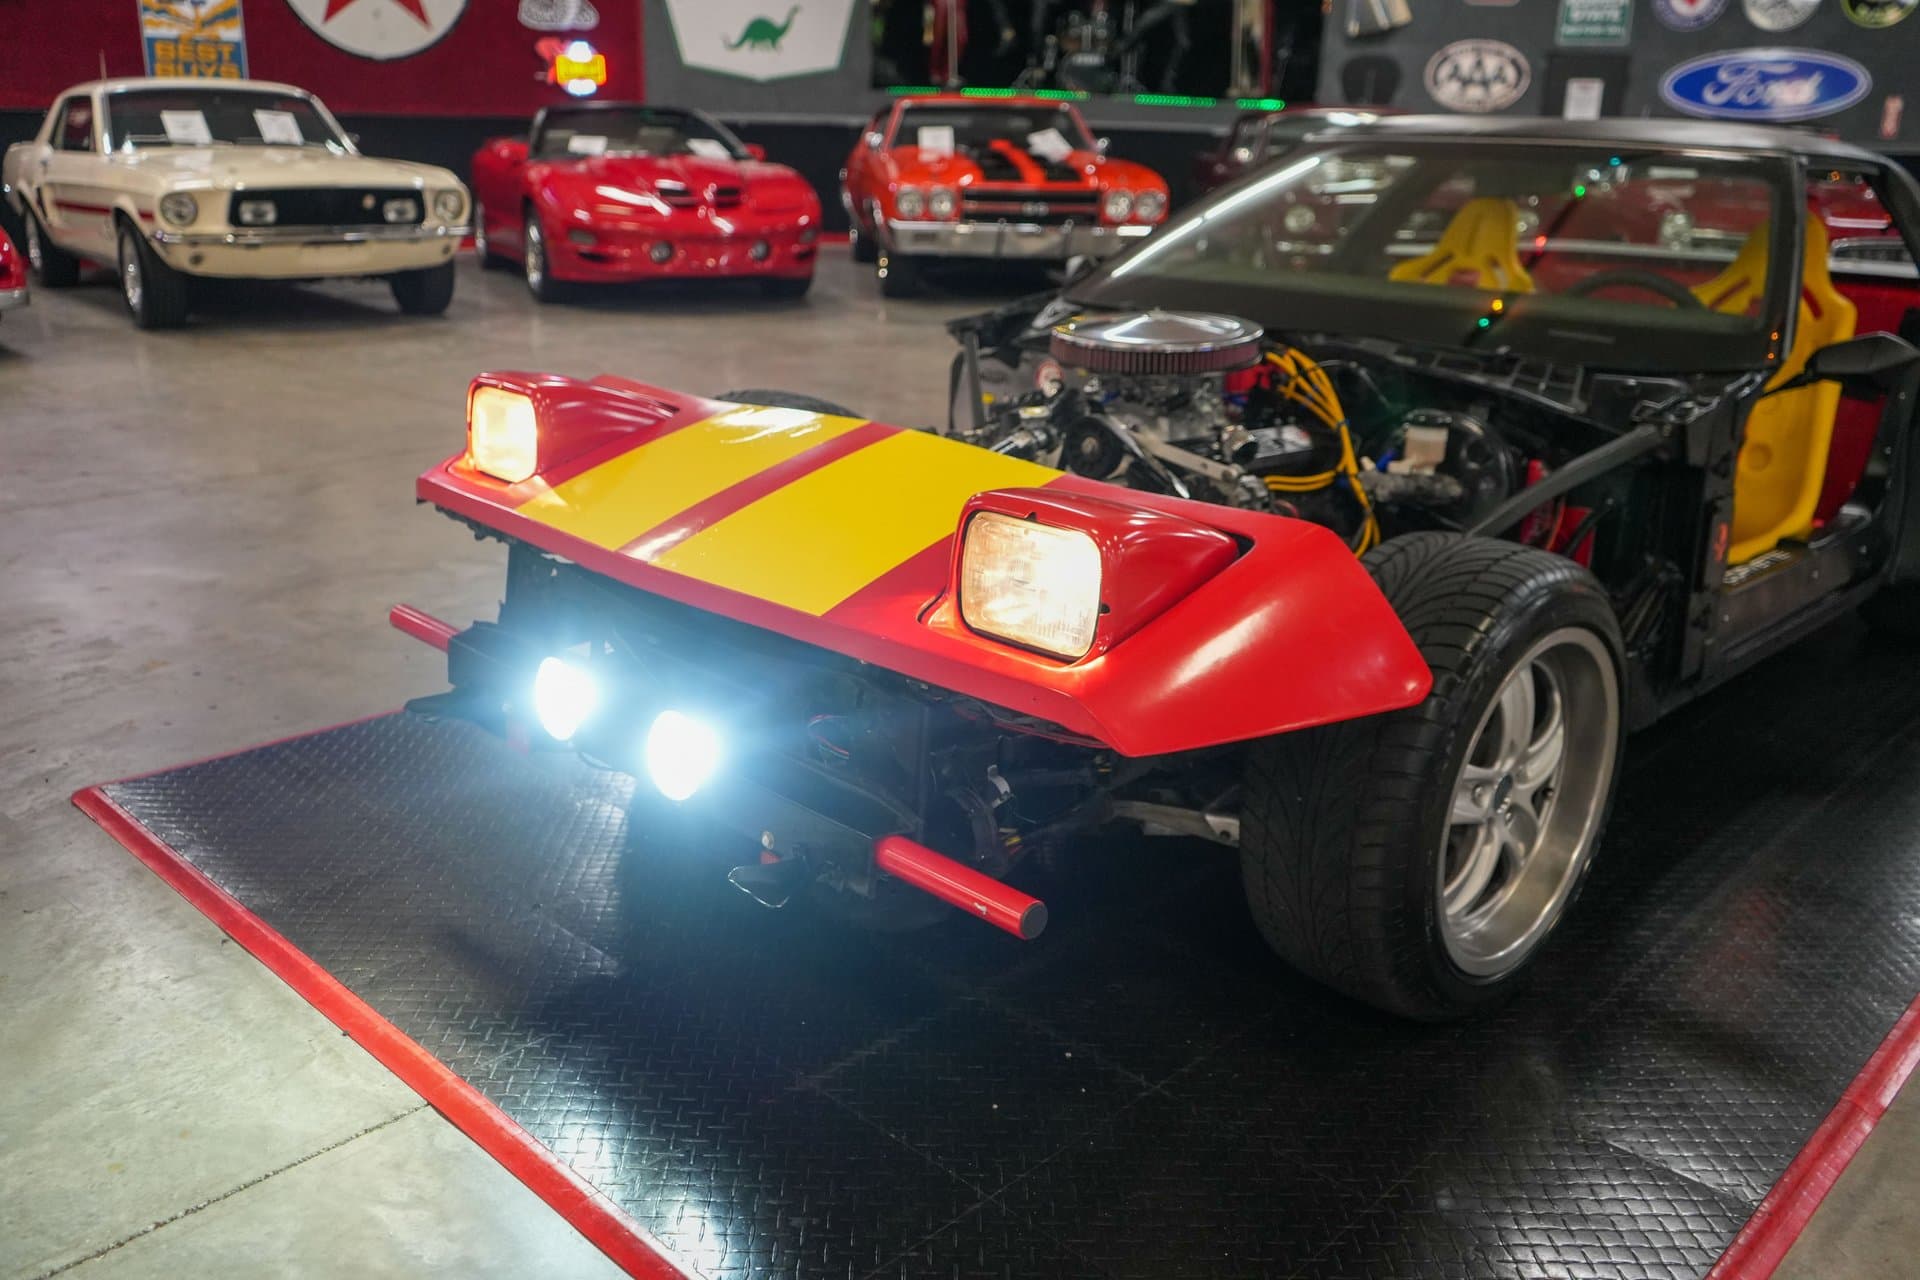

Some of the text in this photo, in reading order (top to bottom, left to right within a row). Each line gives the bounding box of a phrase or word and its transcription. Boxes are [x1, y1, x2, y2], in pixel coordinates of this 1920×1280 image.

[154, 40, 235, 61] BEST
[154, 61, 241, 78] BUYS
[1447, 55, 1508, 92] AAA
[1702, 60, 1825, 107] Ford
